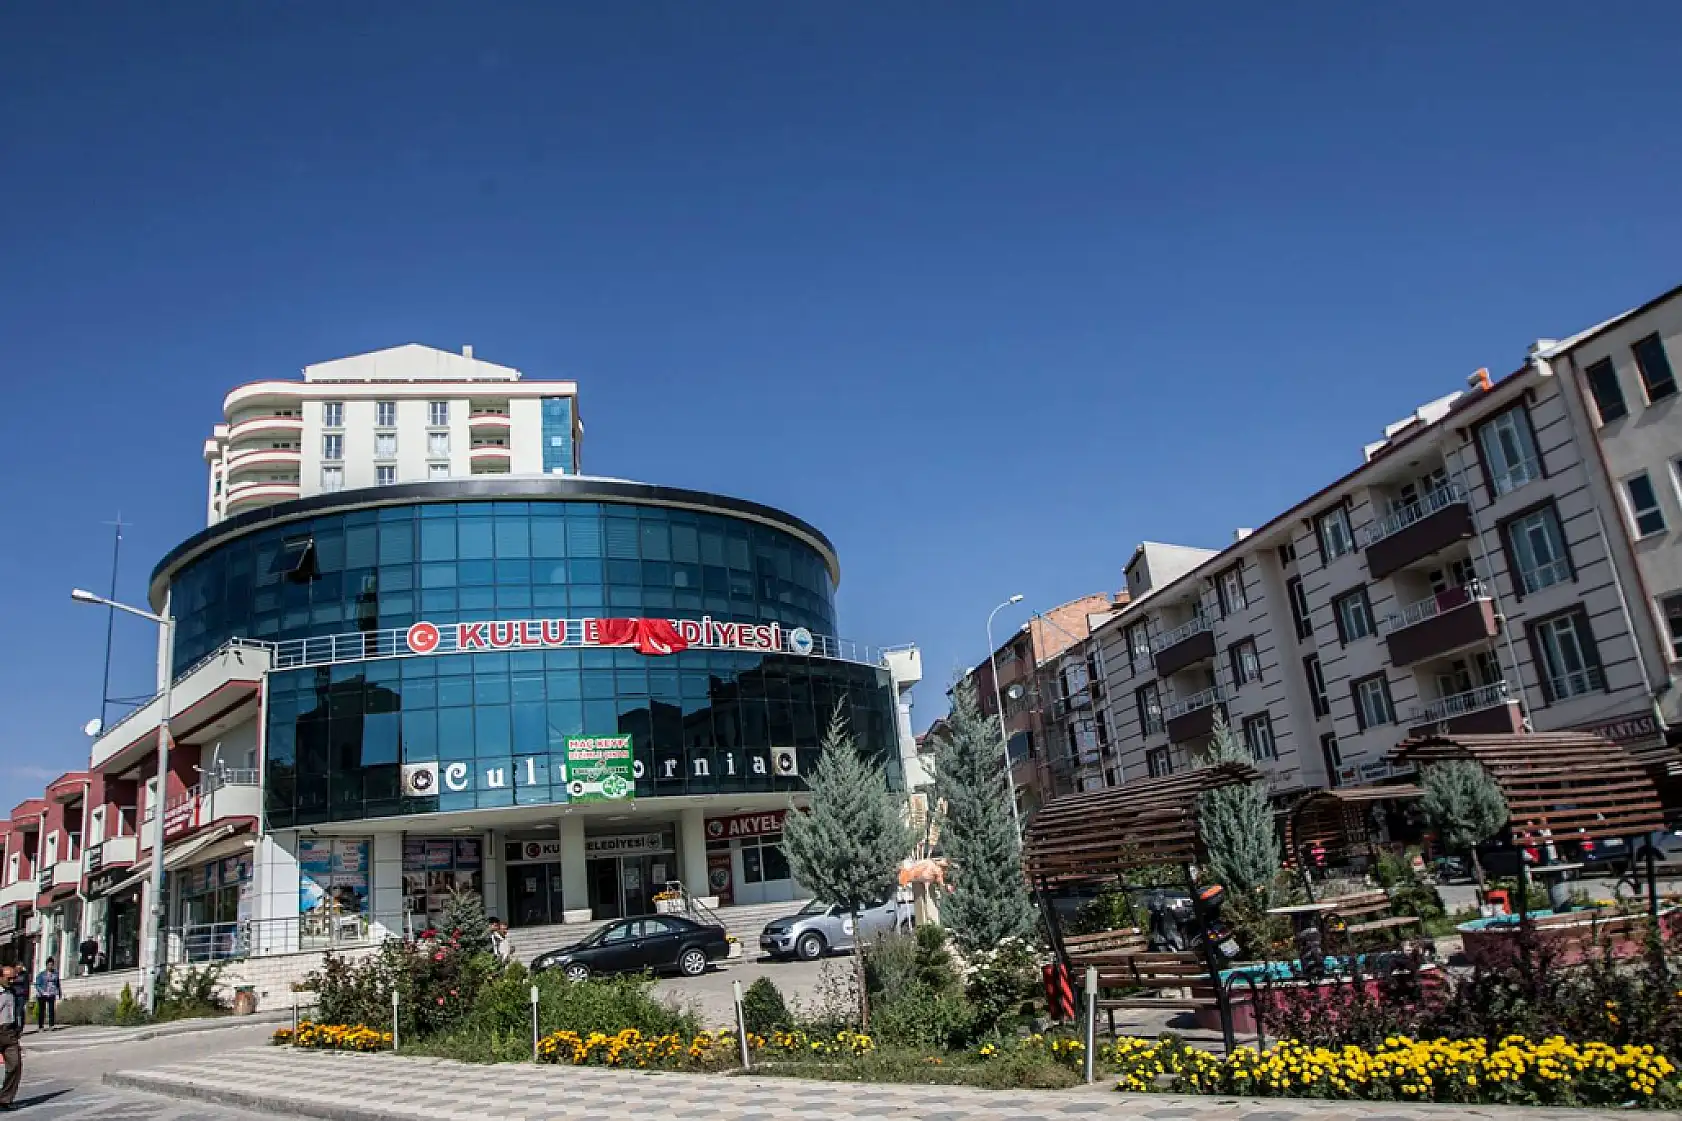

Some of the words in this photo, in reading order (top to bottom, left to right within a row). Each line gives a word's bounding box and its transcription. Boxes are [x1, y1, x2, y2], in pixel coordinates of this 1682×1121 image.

[457, 619, 567, 651] KULU
[543, 844, 560, 854] KU
[586, 837, 645, 851] ELEDİYESİ
